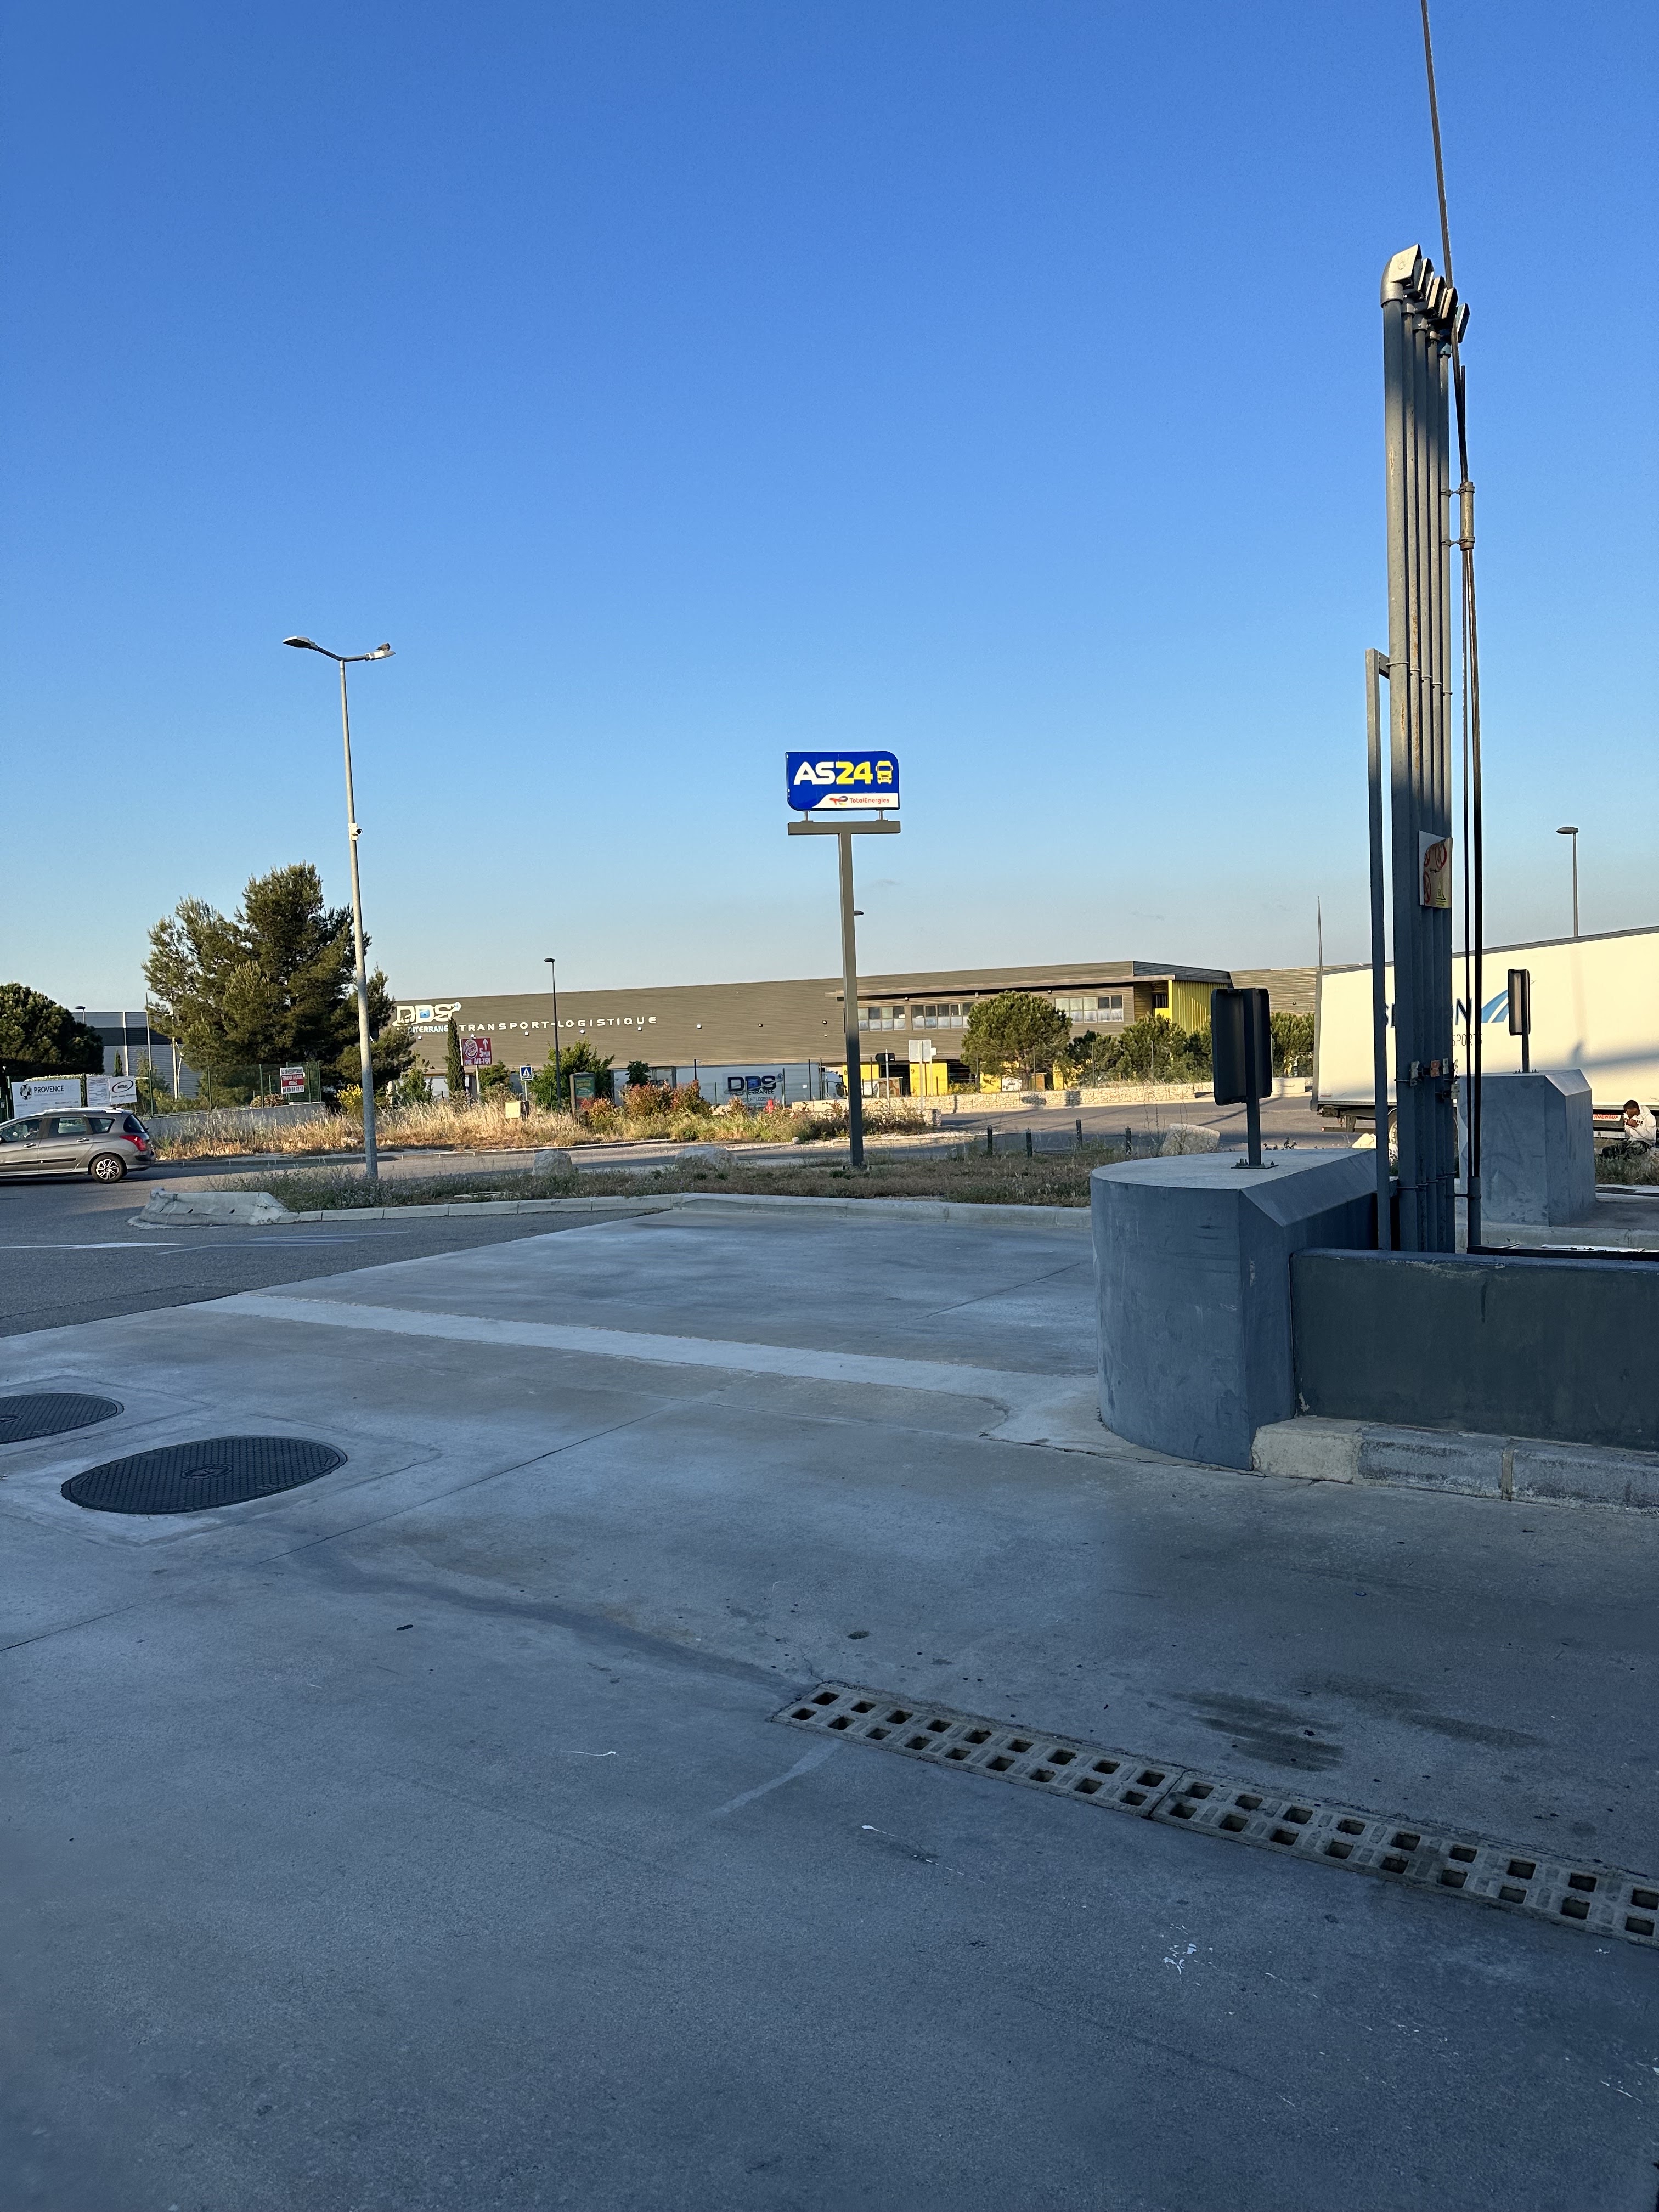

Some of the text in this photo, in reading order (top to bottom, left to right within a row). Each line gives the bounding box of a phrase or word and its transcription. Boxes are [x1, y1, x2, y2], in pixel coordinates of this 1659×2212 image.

[793, 761, 873, 785] AS24
[396, 1004, 452, 1022] DDS
[479, 1047, 483, 1057] 5
[33, 1085, 64, 1093] PROVENCE
[727, 1075, 777, 1091] DDS
